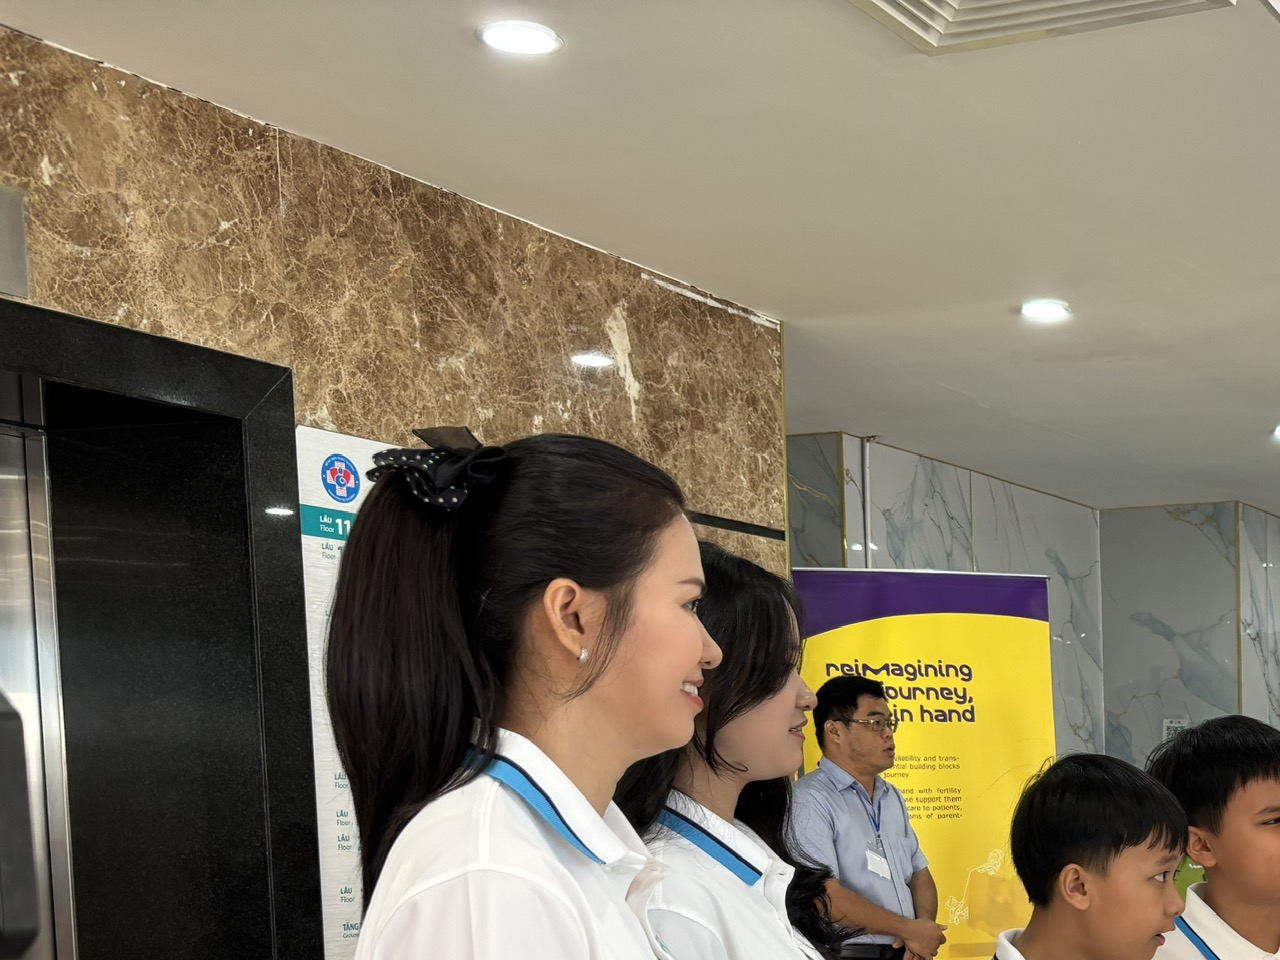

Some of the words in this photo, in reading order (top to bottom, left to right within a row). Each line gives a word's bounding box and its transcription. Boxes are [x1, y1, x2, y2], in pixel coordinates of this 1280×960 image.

[320, 524, 334, 533] Floor
[322, 551, 336, 560] Floor
[884, 686, 974, 705] ourney,
[920, 704, 976, 723] hand
[910, 763, 936, 771] building
